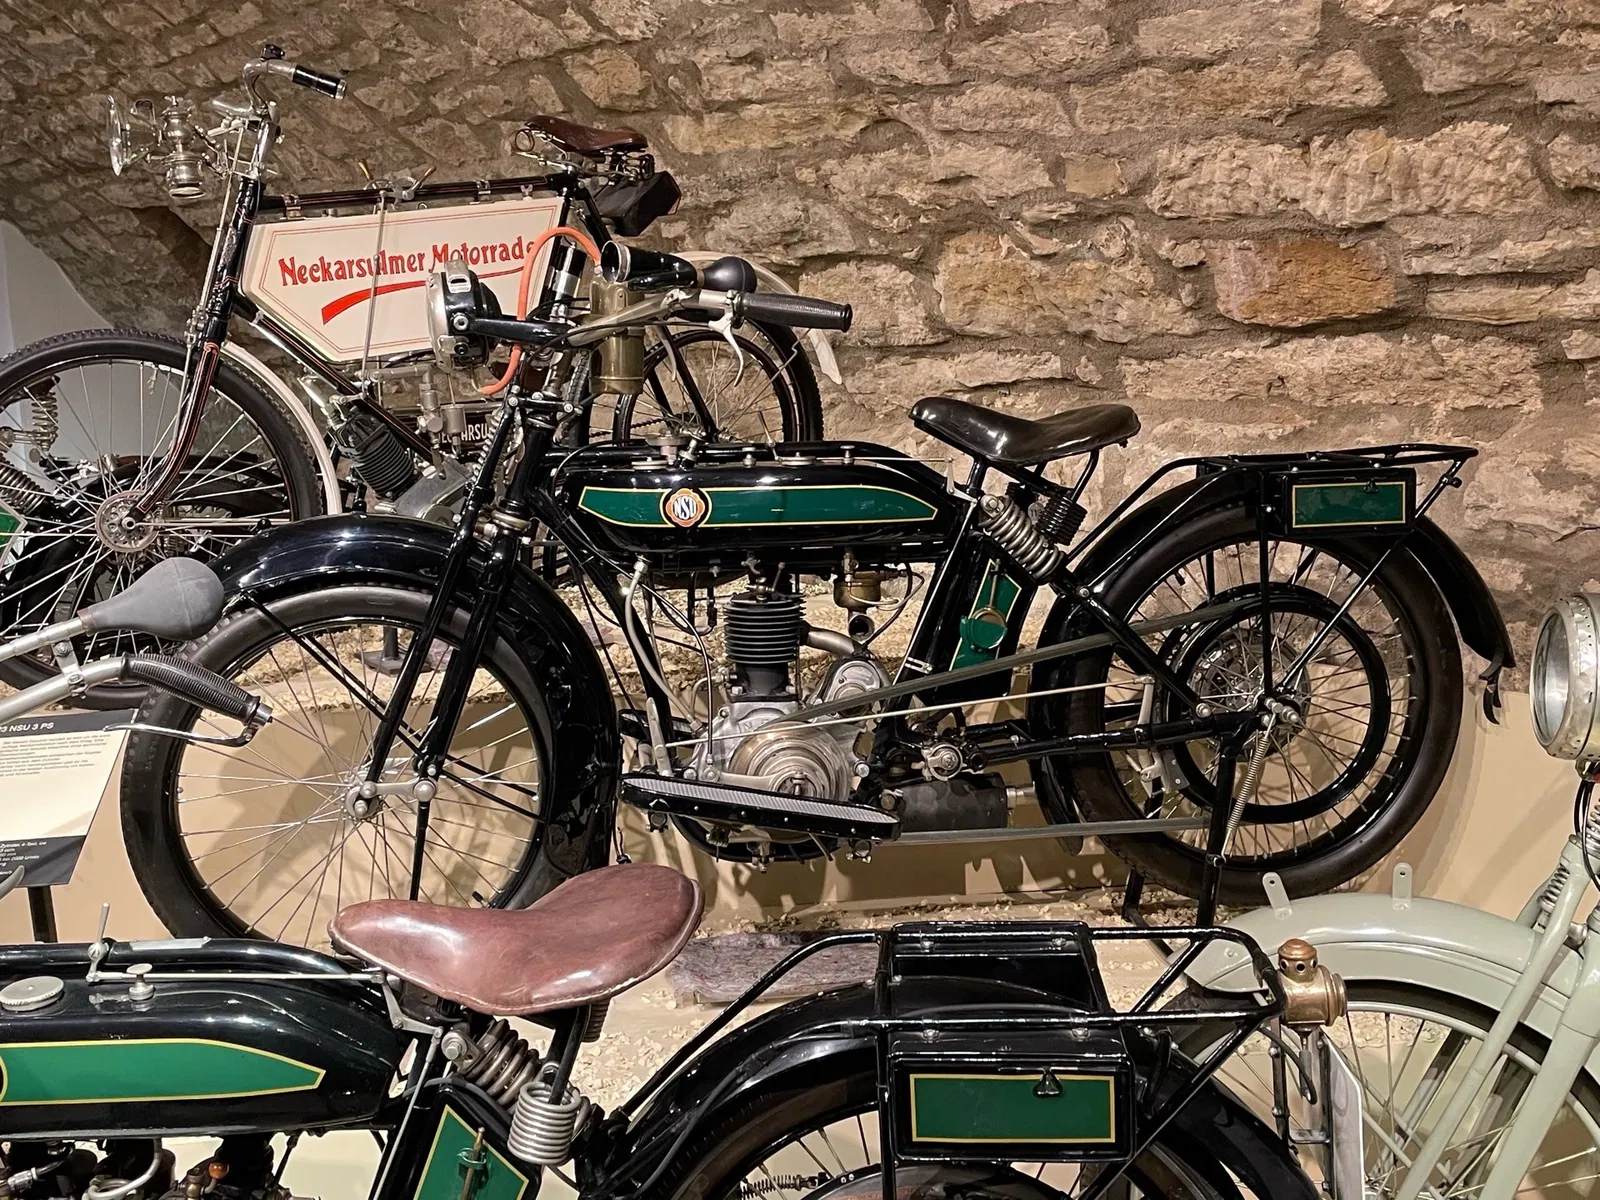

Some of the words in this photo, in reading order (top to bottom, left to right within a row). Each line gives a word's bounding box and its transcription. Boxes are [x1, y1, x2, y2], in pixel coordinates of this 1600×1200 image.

[278, 249, 426, 287] Neckarsulmer
[674, 496, 697, 520] NSU
[9, 723, 32, 732] NSU
[32, 723, 39, 731] 3
[40, 722, 55, 730] PS
